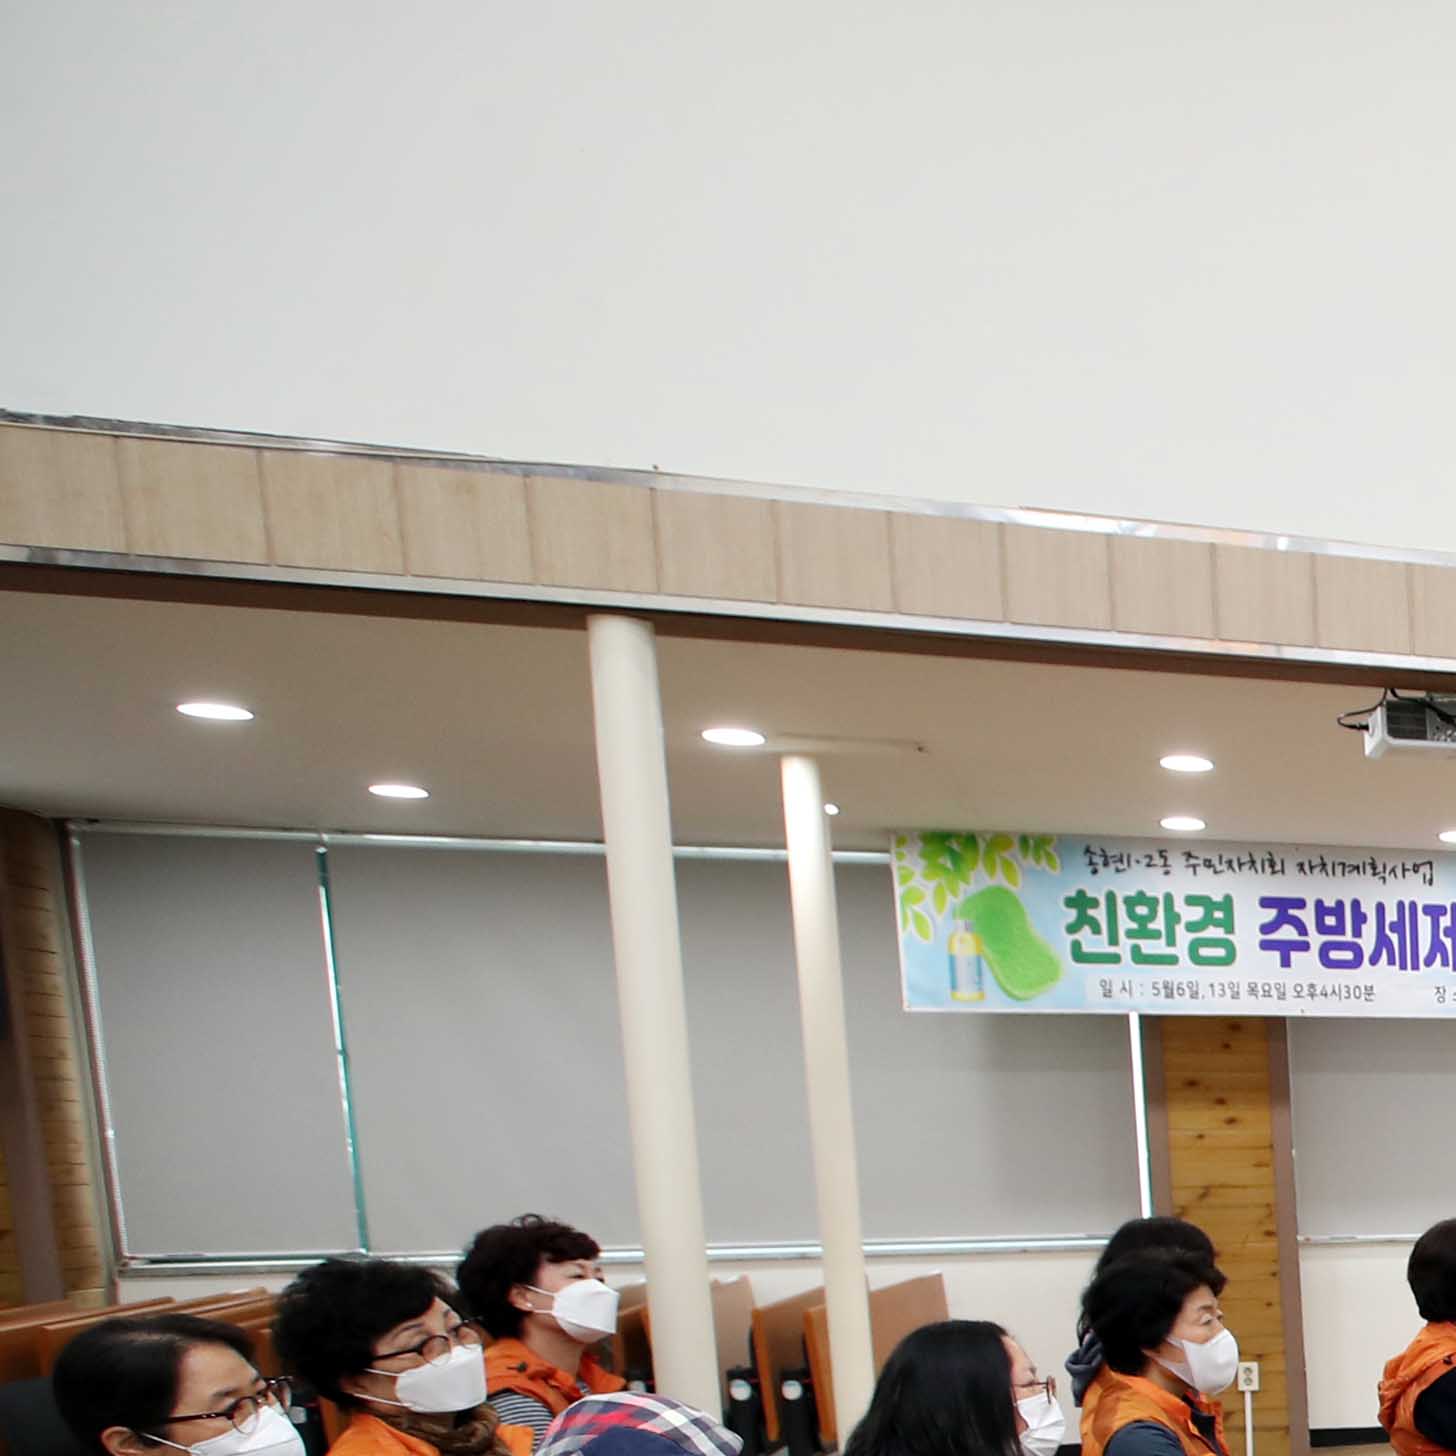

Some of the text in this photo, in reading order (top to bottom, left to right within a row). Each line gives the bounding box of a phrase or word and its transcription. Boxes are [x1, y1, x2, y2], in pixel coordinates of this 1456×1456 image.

[1181, 849, 1285, 877] 주민자치회
[1296, 853, 1434, 887] 자치계획사업
[1063, 888, 1237, 967] 친환경
[1099, 978, 1112, 999] 일
[1119, 979, 1133, 998] 시
[1246, 981, 1287, 1001] 목요일
[1292, 981, 1377, 1002] 오후4시30분
[1434, 985, 1446, 1004] 장
